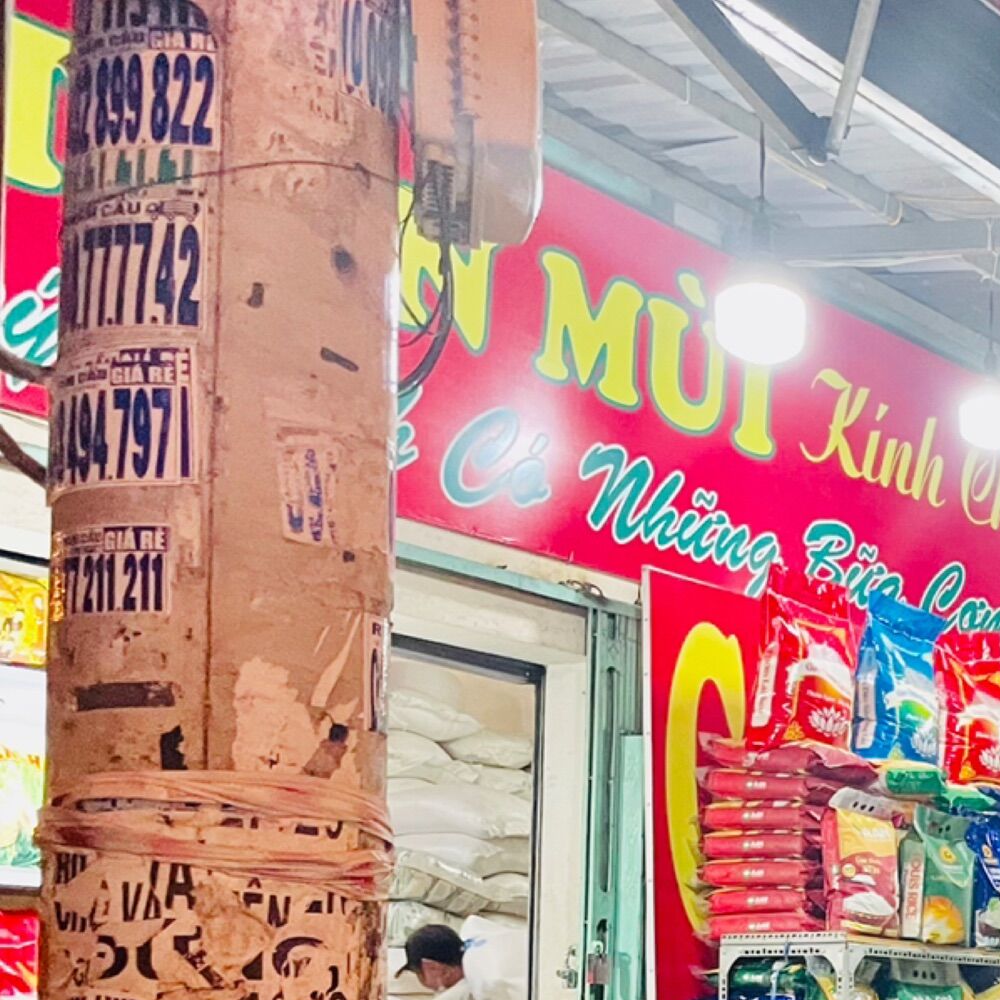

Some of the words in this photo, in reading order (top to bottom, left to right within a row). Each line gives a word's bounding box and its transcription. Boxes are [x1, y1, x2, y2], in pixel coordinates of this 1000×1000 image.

[441, 408, 552, 507] Có
[579, 444, 780, 598] Những
[803, 518, 906, 608] Bữa
[800, 367, 945, 509] Kính
